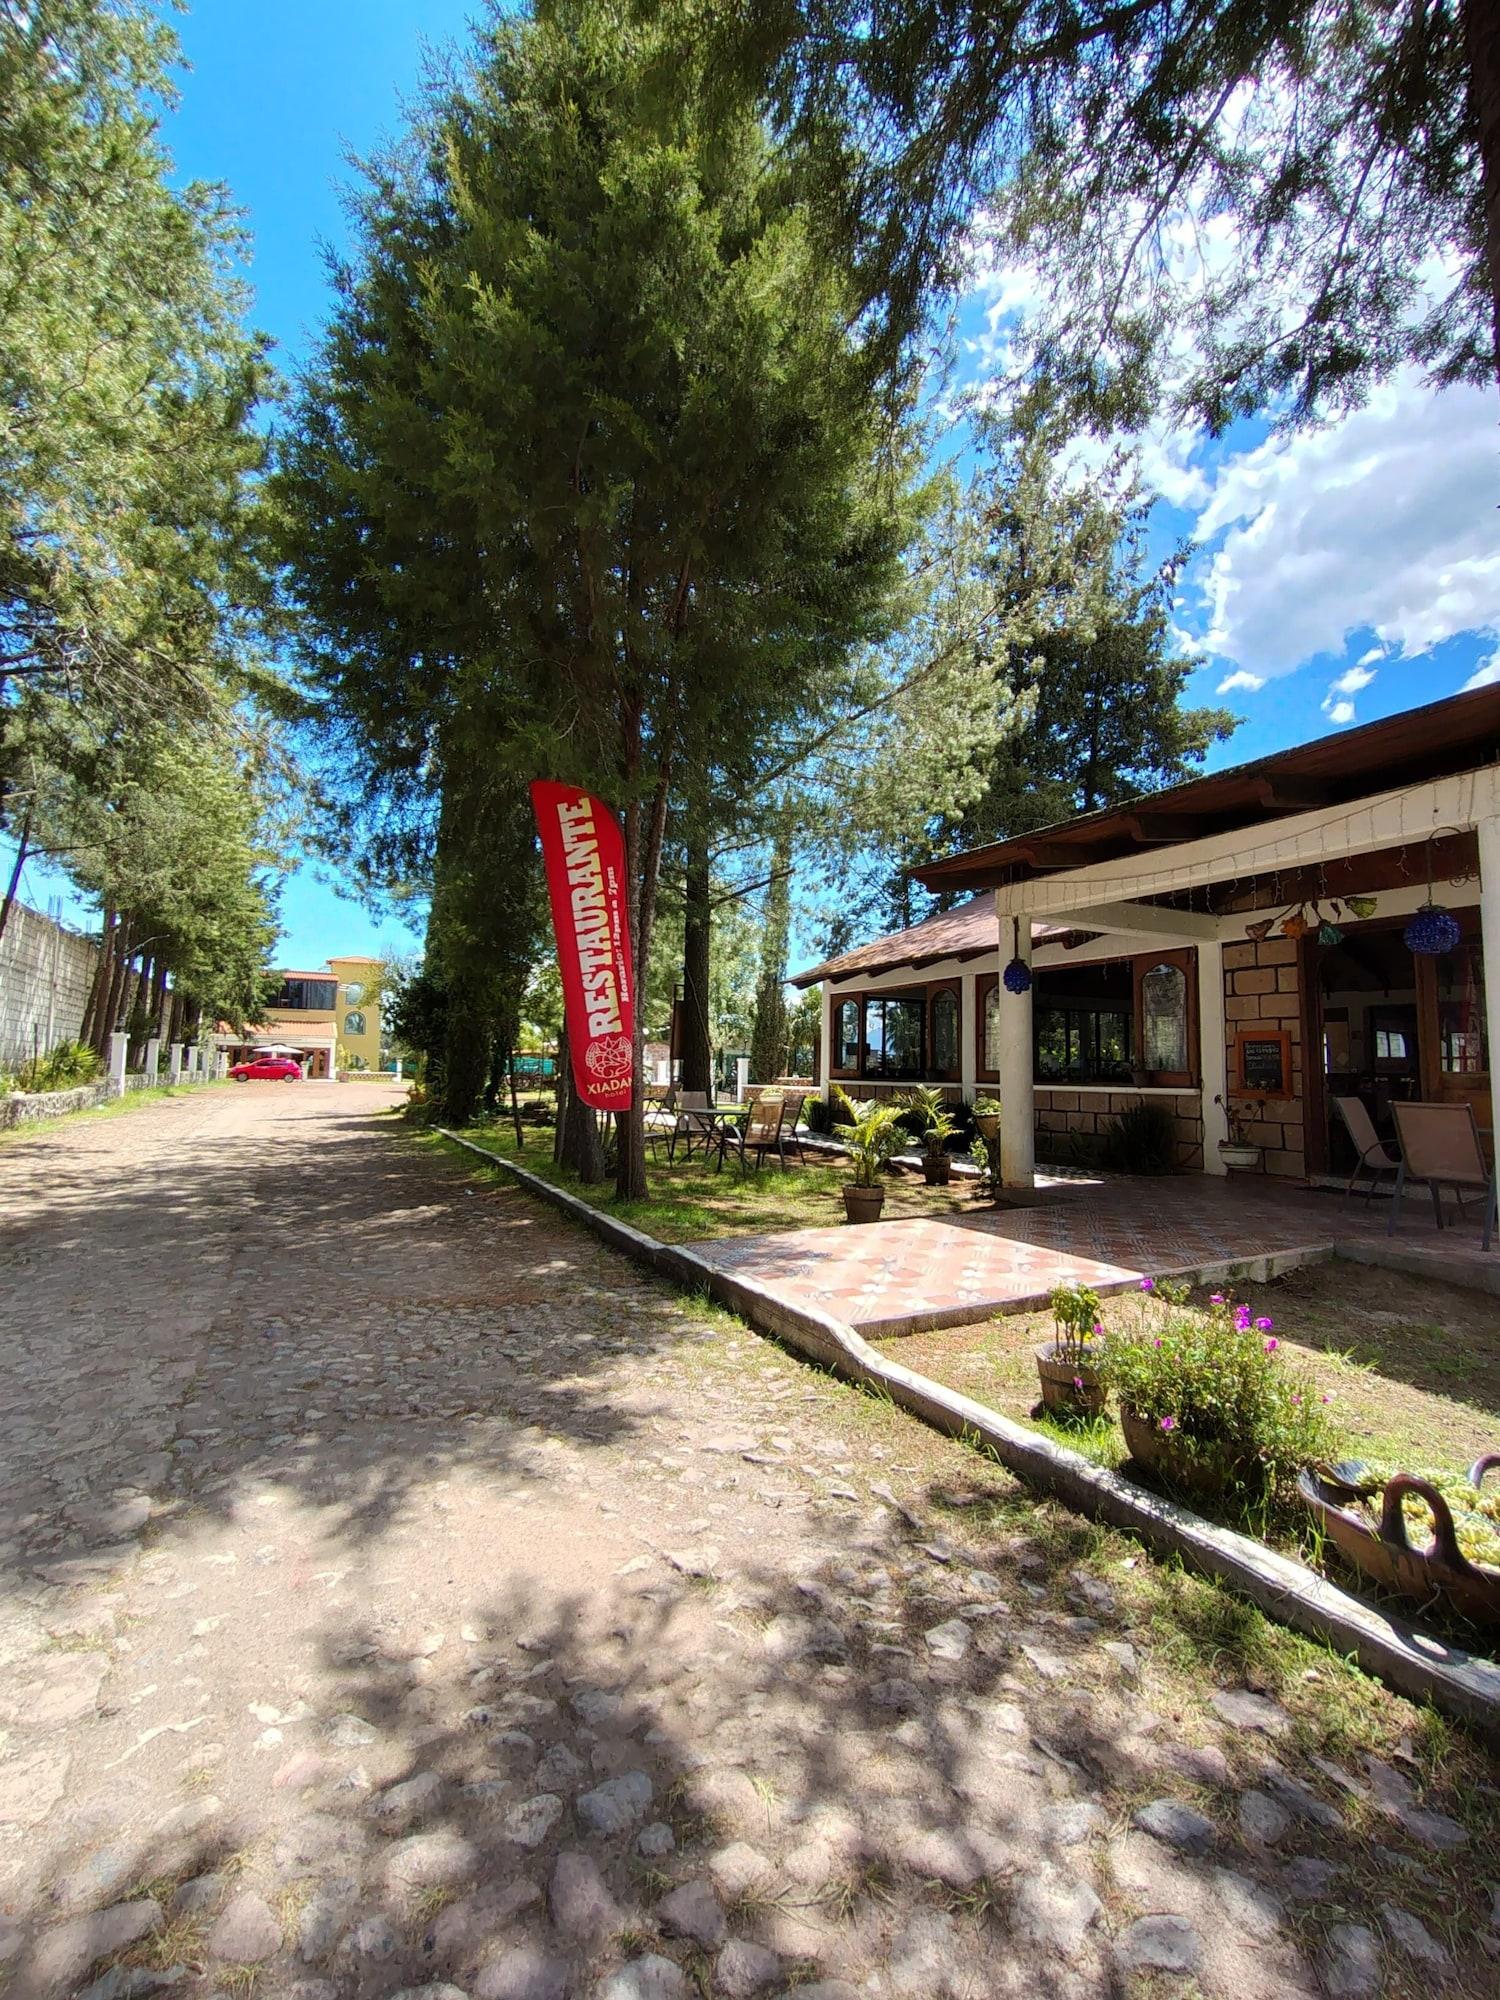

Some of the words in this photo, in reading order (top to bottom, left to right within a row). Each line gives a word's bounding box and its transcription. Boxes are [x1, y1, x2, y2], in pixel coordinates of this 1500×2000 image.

[607, 866, 618, 895] 7pm
[557, 798, 623, 1038] RESTAURANTE
[611, 899, 618, 909] a
[613, 910, 622, 946] 12pm
[615, 949, 629, 1003] Horario:
